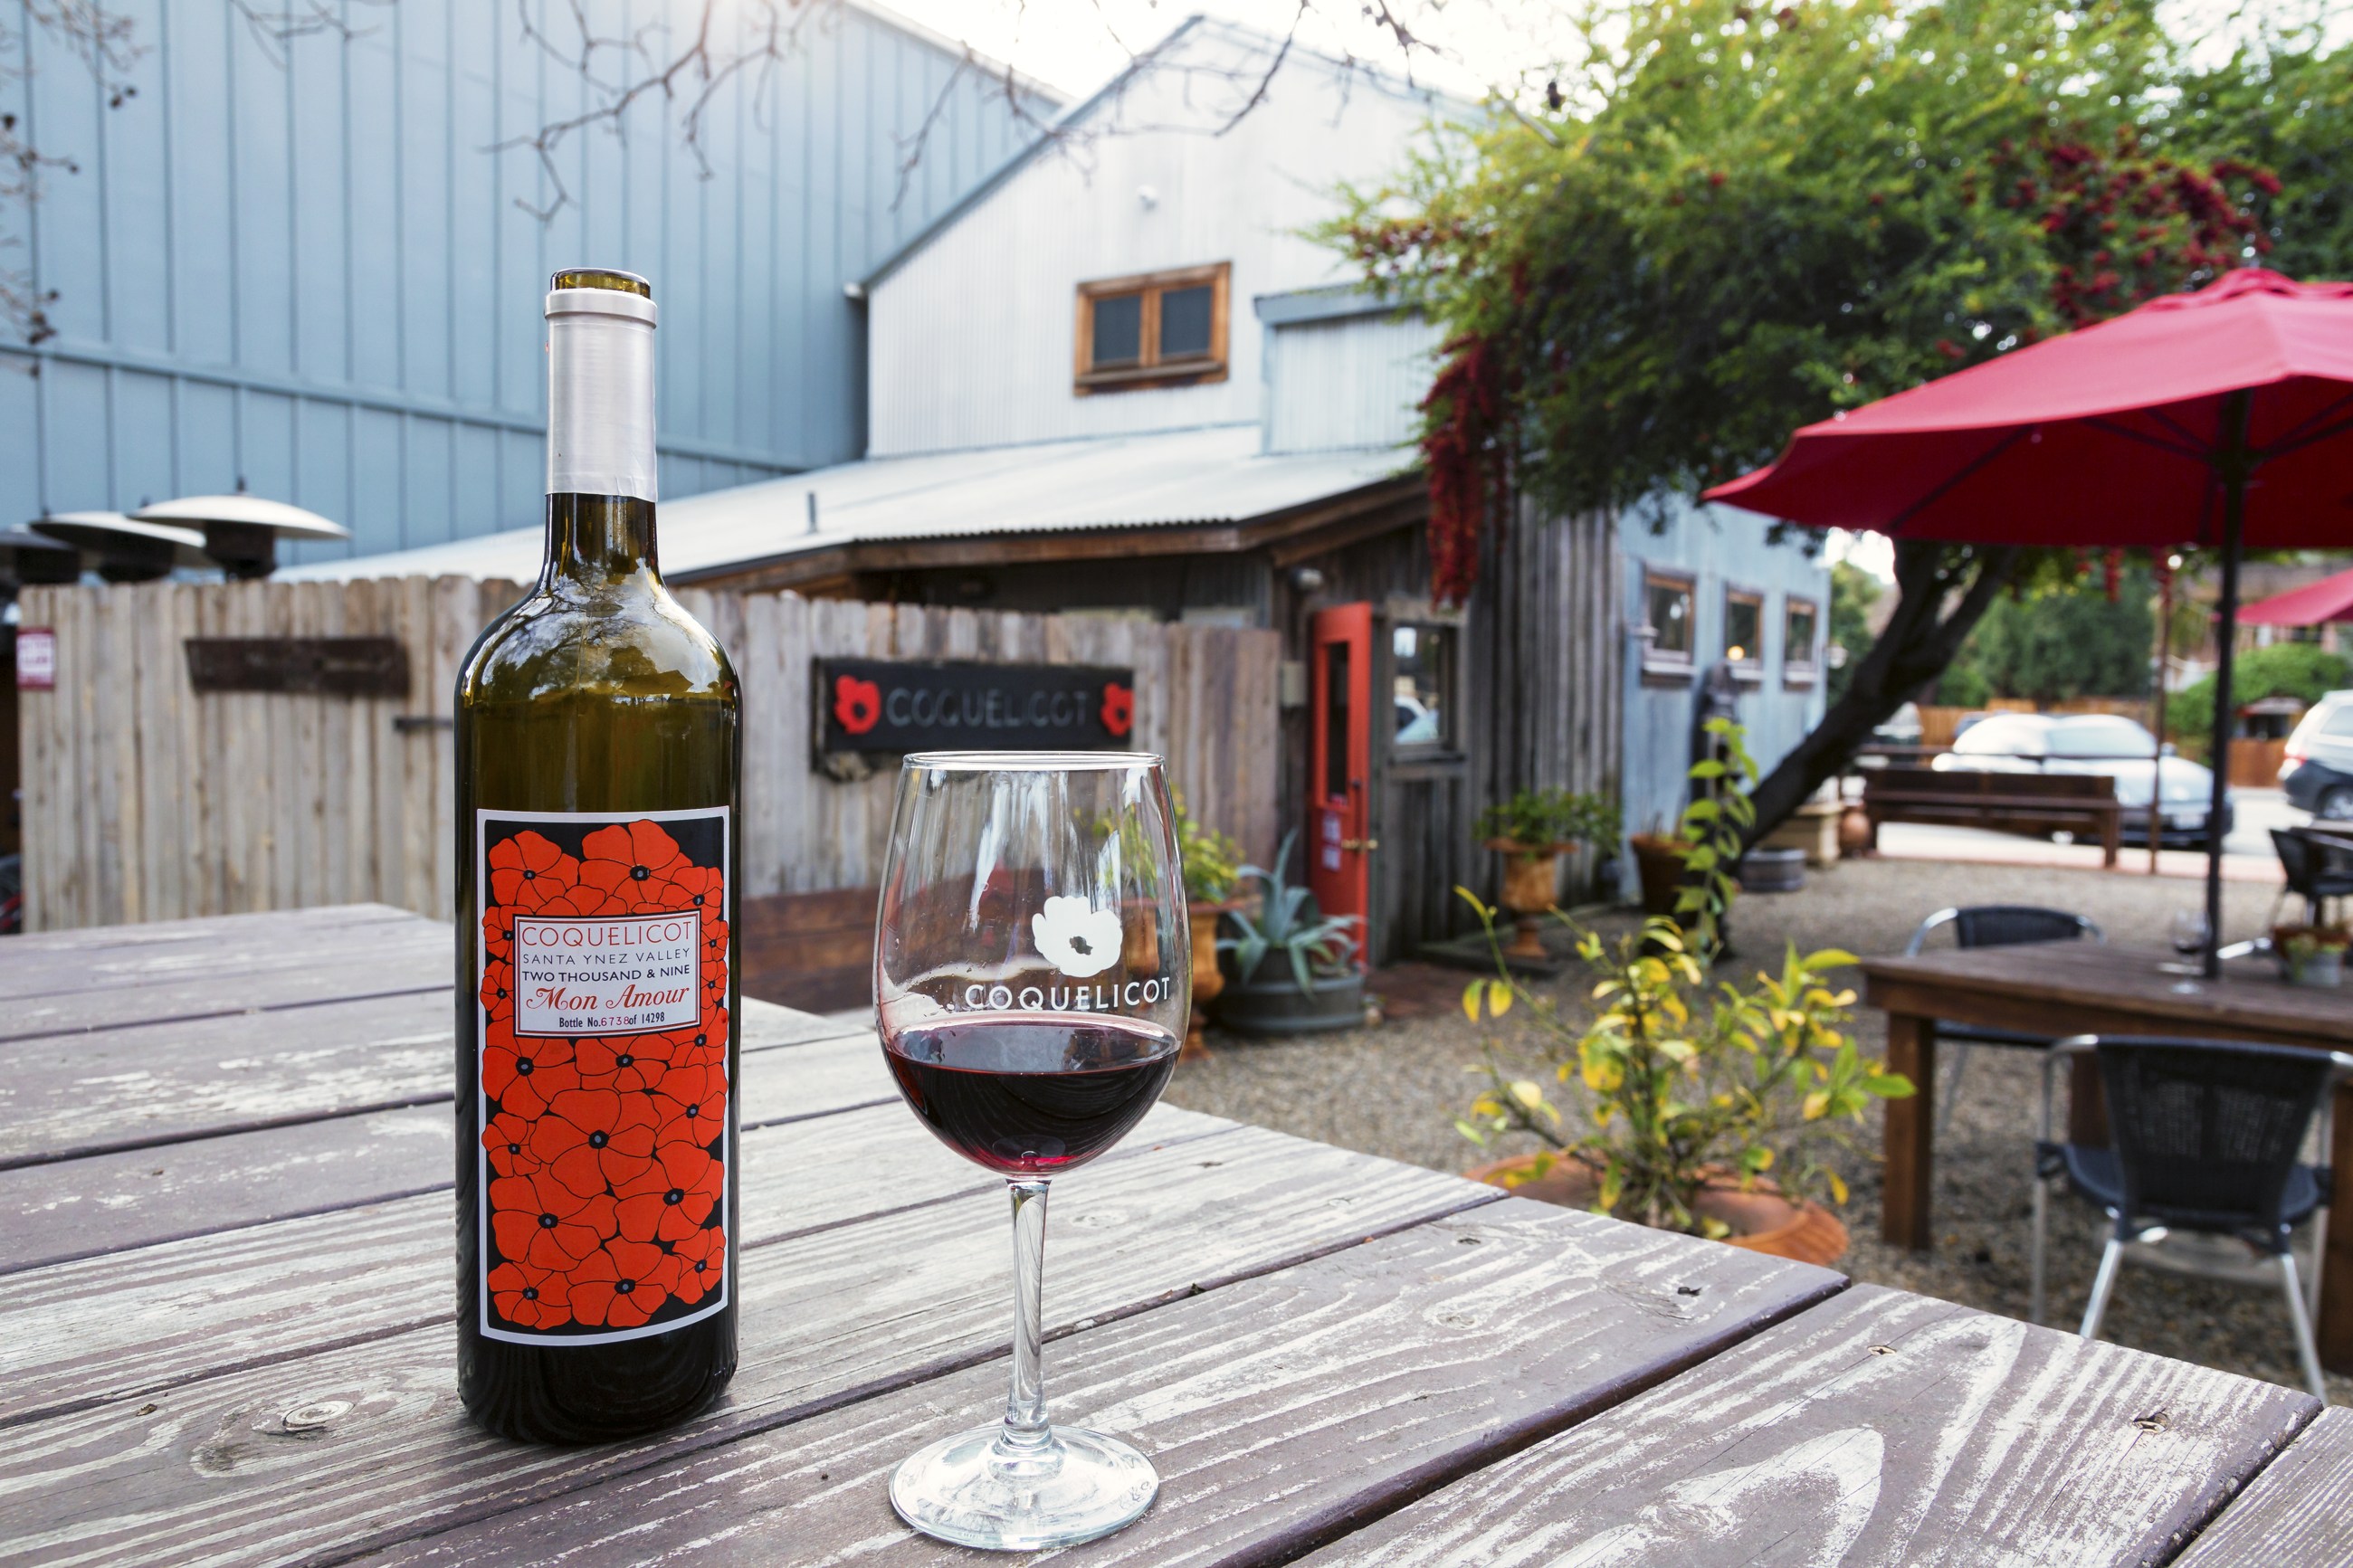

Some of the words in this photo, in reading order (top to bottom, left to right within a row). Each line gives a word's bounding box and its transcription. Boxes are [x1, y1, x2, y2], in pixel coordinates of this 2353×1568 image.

[522, 921, 691, 947] COQUELICOT
[523, 954, 576, 965] SANTA
[583, 954, 628, 965] YNEZ
[635, 947, 690, 963] VALLEY
[522, 971, 555, 983] TWO
[558, 970, 642, 983] THOUSAND
[647, 969, 656, 979] &
[661, 965, 691, 976] NINE
[526, 986, 597, 1011] Mon
[605, 984, 690, 1009] Amour
[965, 977, 1169, 1011] COQUELICOT
[559, 1017, 583, 1028] Bottle
[642, 1012, 665, 1023] 14298
